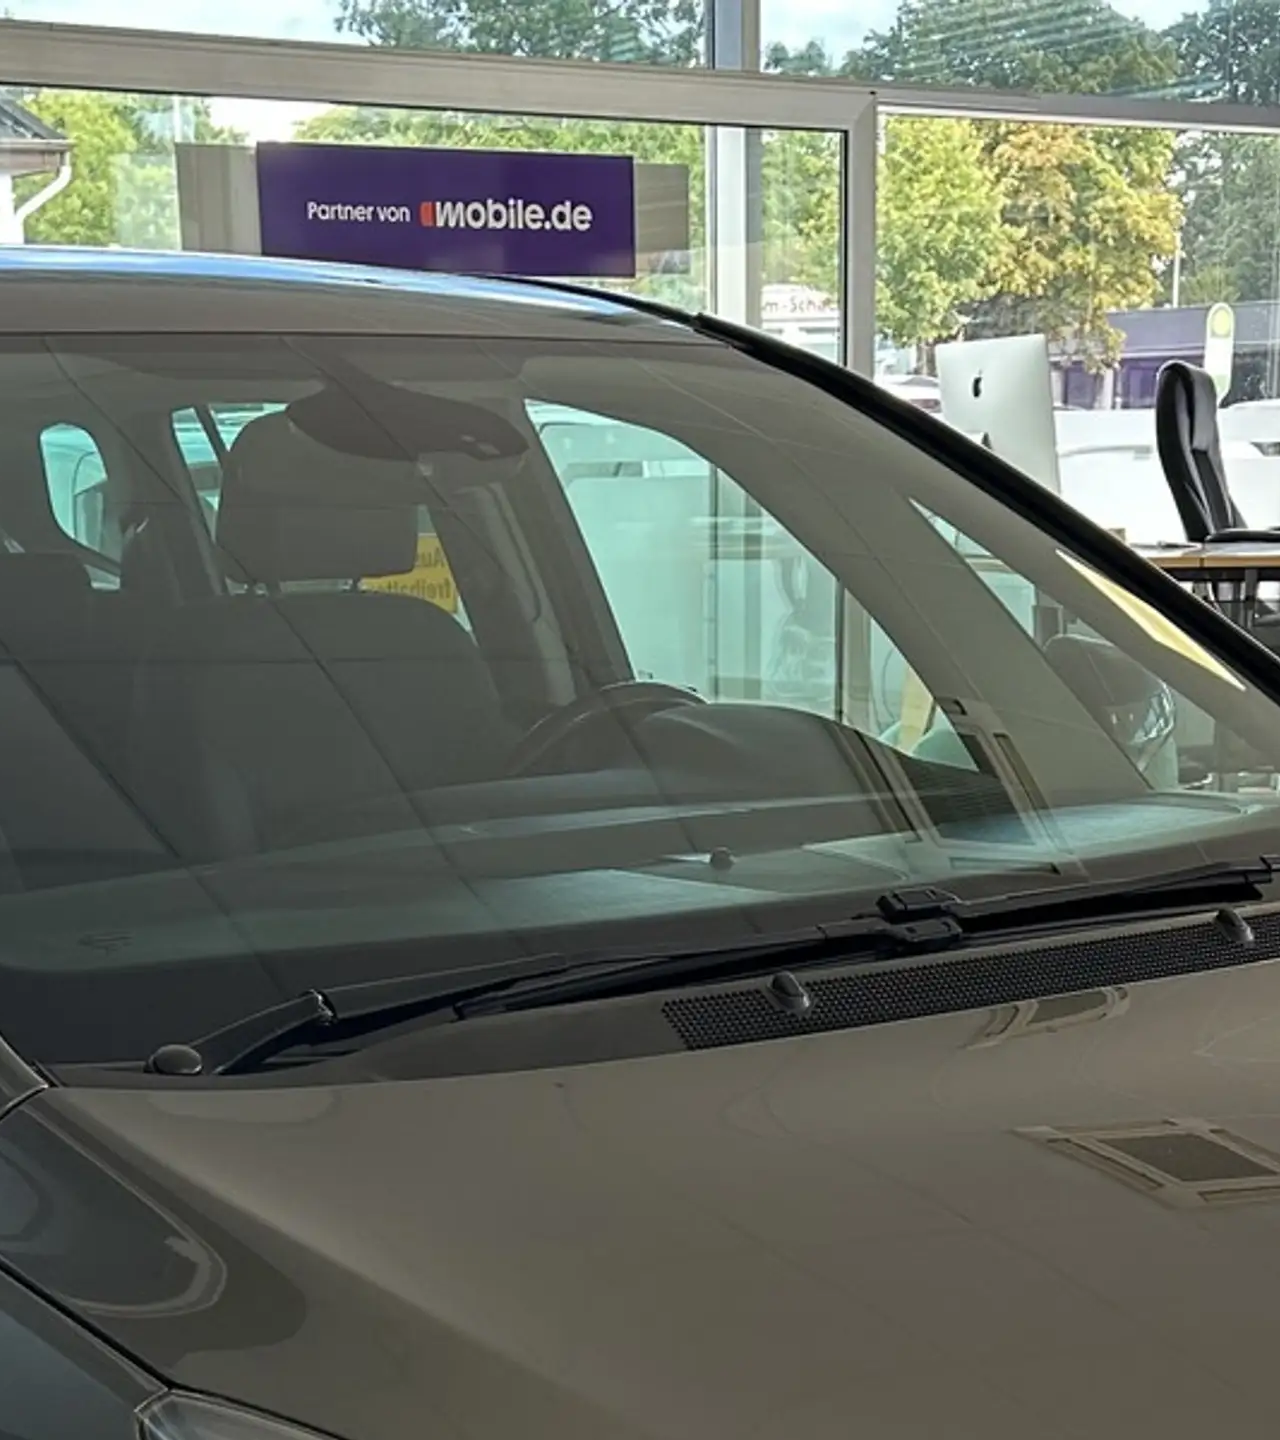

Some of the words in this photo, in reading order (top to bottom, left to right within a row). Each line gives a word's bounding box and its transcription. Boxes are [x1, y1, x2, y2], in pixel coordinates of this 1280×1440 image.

[306, 202, 374, 223] Partner
[376, 205, 411, 223] von
[435, 198, 593, 231] mobile.de
